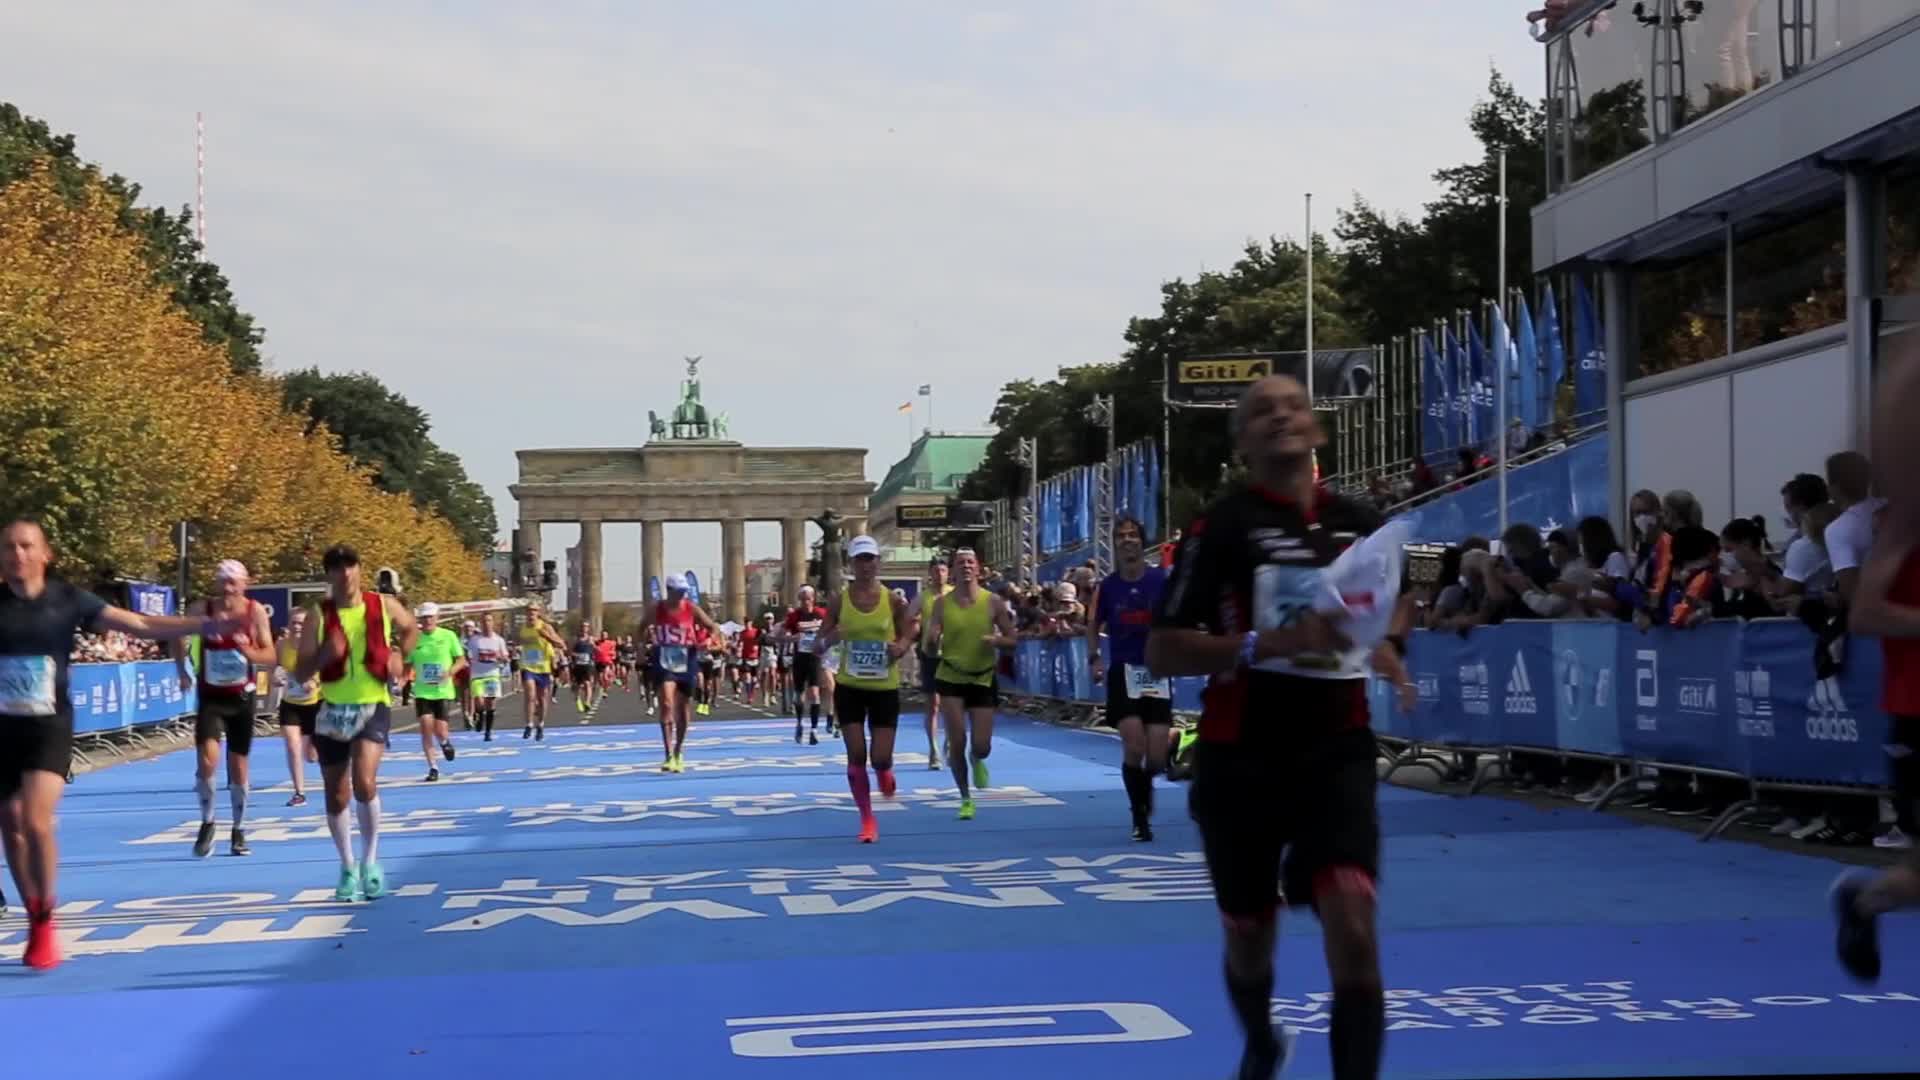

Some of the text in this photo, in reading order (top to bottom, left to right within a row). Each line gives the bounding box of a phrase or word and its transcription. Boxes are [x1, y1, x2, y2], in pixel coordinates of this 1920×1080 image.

[1185, 364, 1238, 380] Giti
[656, 622, 697, 646] USA
[1679, 684, 1704, 708] Giti
[1804, 717, 1859, 742] adidas
[442, 865, 1209, 909] BERLIN
[424, 879, 1216, 933] BMW
